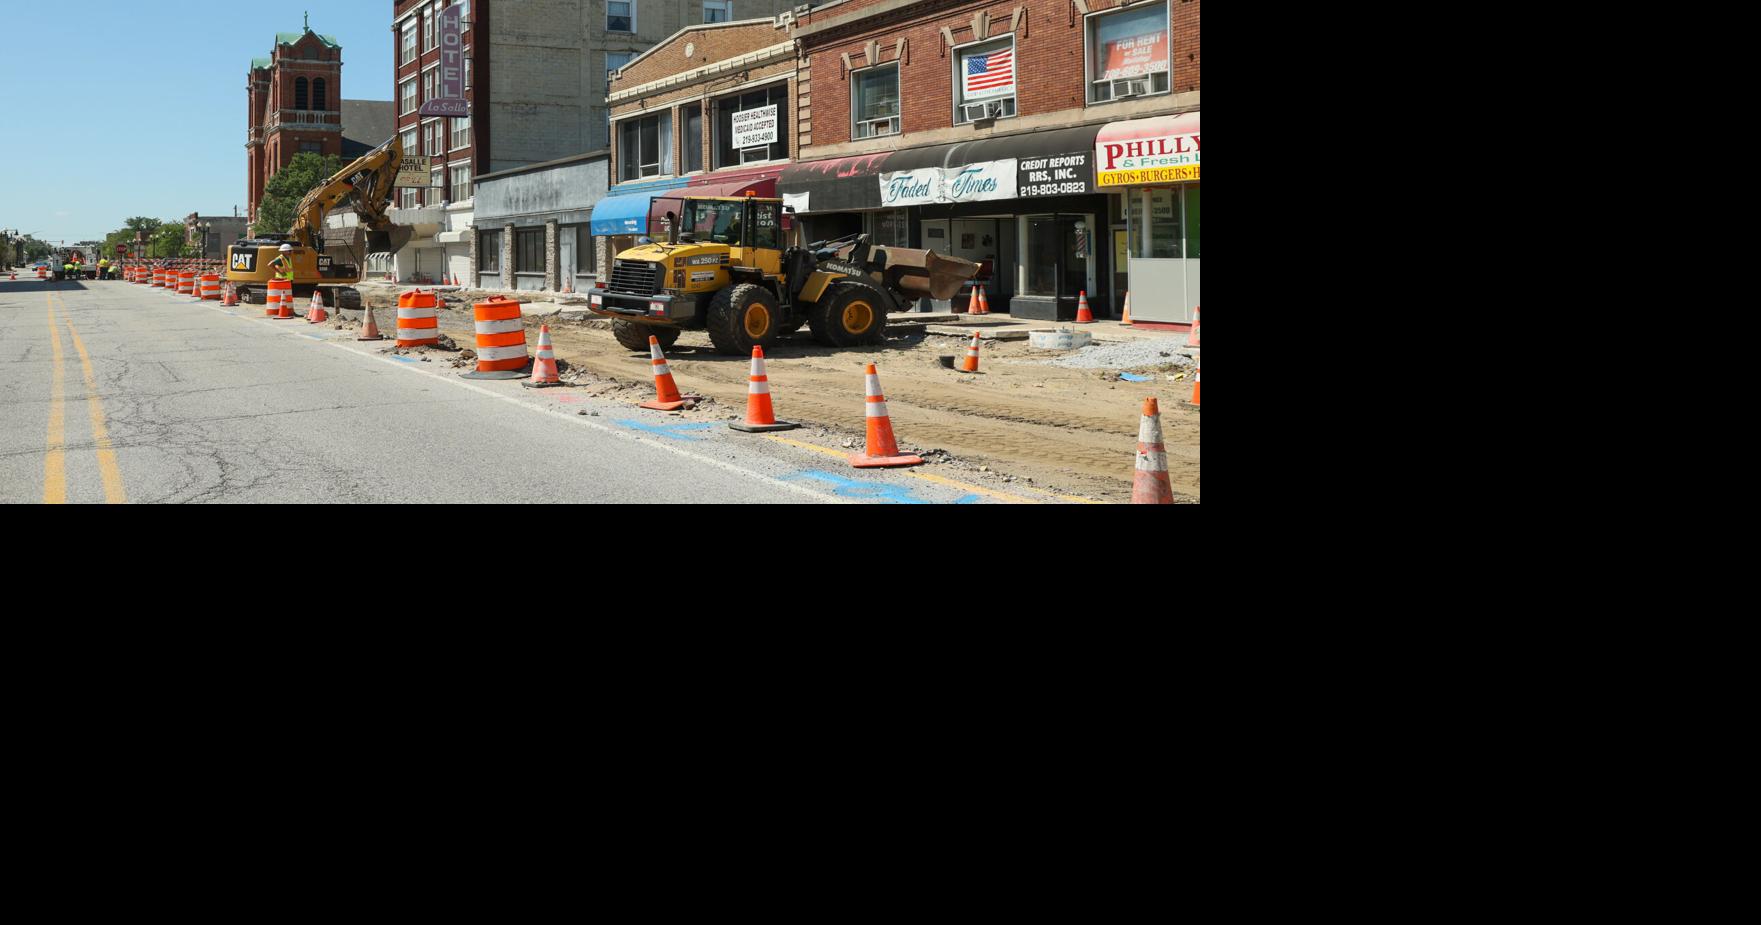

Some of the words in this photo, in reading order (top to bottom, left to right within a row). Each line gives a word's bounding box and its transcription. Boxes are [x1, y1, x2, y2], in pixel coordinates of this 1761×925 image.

[1116, 38, 1135, 51] FOR
[1137, 32, 1162, 46] RENT
[443, 15, 459, 98] HOTEL
[1132, 45, 1153, 57] SALE
[735, 123, 753, 134] MEDICAID
[754, 119, 774, 131] ACCEPTED
[1103, 135, 1200, 170] PHILLY
[400, 158, 427, 166] ASALLE
[1020, 159, 1048, 171] CREDIT
[1049, 155, 1085, 168] REPORTS
[1123, 159, 1134, 168] &
[1140, 155, 1190, 167] Fresh
[1029, 170, 1052, 182] RRS,
[1054, 168, 1077, 180] INC.
[1103, 172, 1136, 185] GYROS
[1140, 167, 1188, 182] BURGERS
[887, 175, 932, 202] Faded
[951, 168, 998, 198] Times
[1020, 181, 1085, 197] 219-803-0823
[232, 253, 252, 270] CAT
[318, 258, 332, 266] CAT
[826, 262, 861, 277] KOMATSU
